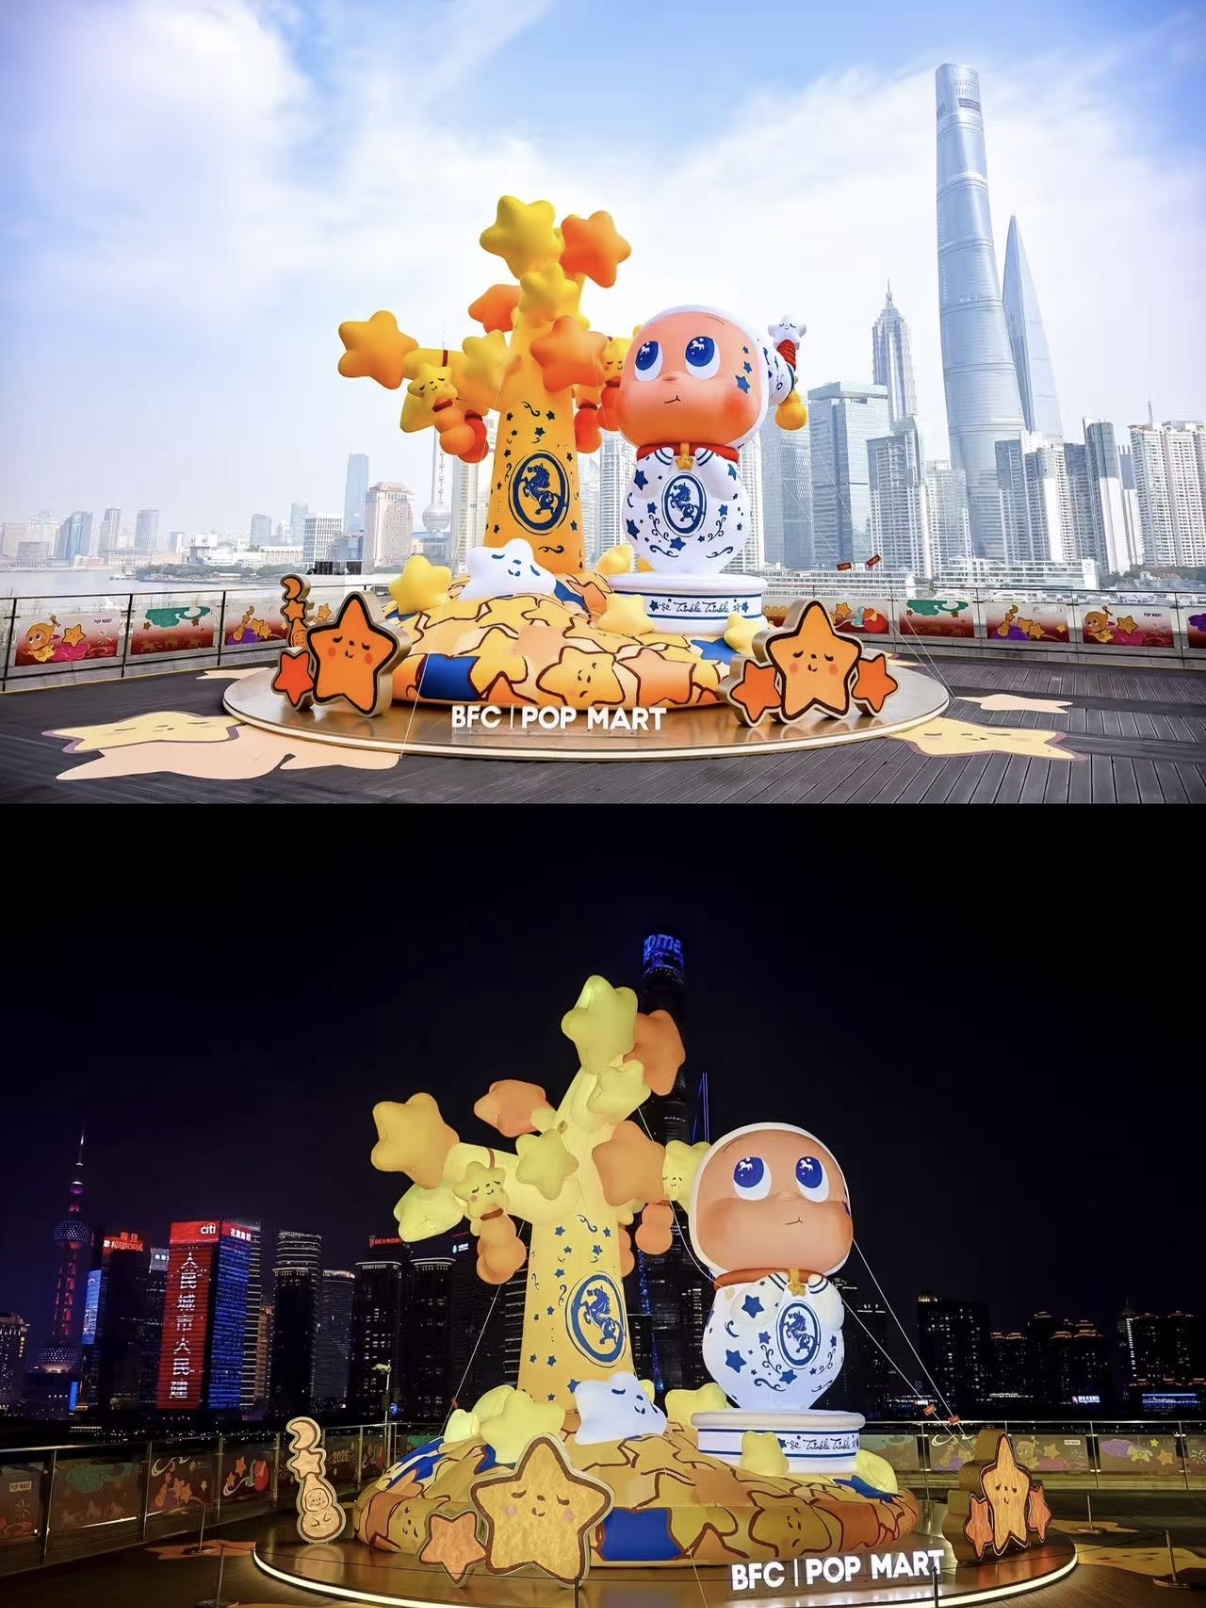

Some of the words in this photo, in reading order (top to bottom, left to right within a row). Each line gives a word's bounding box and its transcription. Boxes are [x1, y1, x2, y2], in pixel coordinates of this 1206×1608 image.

[451, 705, 502, 729] BFC
[521, 706, 577, 730] POP
[587, 706, 667, 731] MART
[200, 1223, 216, 1235] citi
[731, 1561, 786, 1591] BFC
[805, 1556, 861, 1585] POP
[870, 1549, 945, 1580] MART
